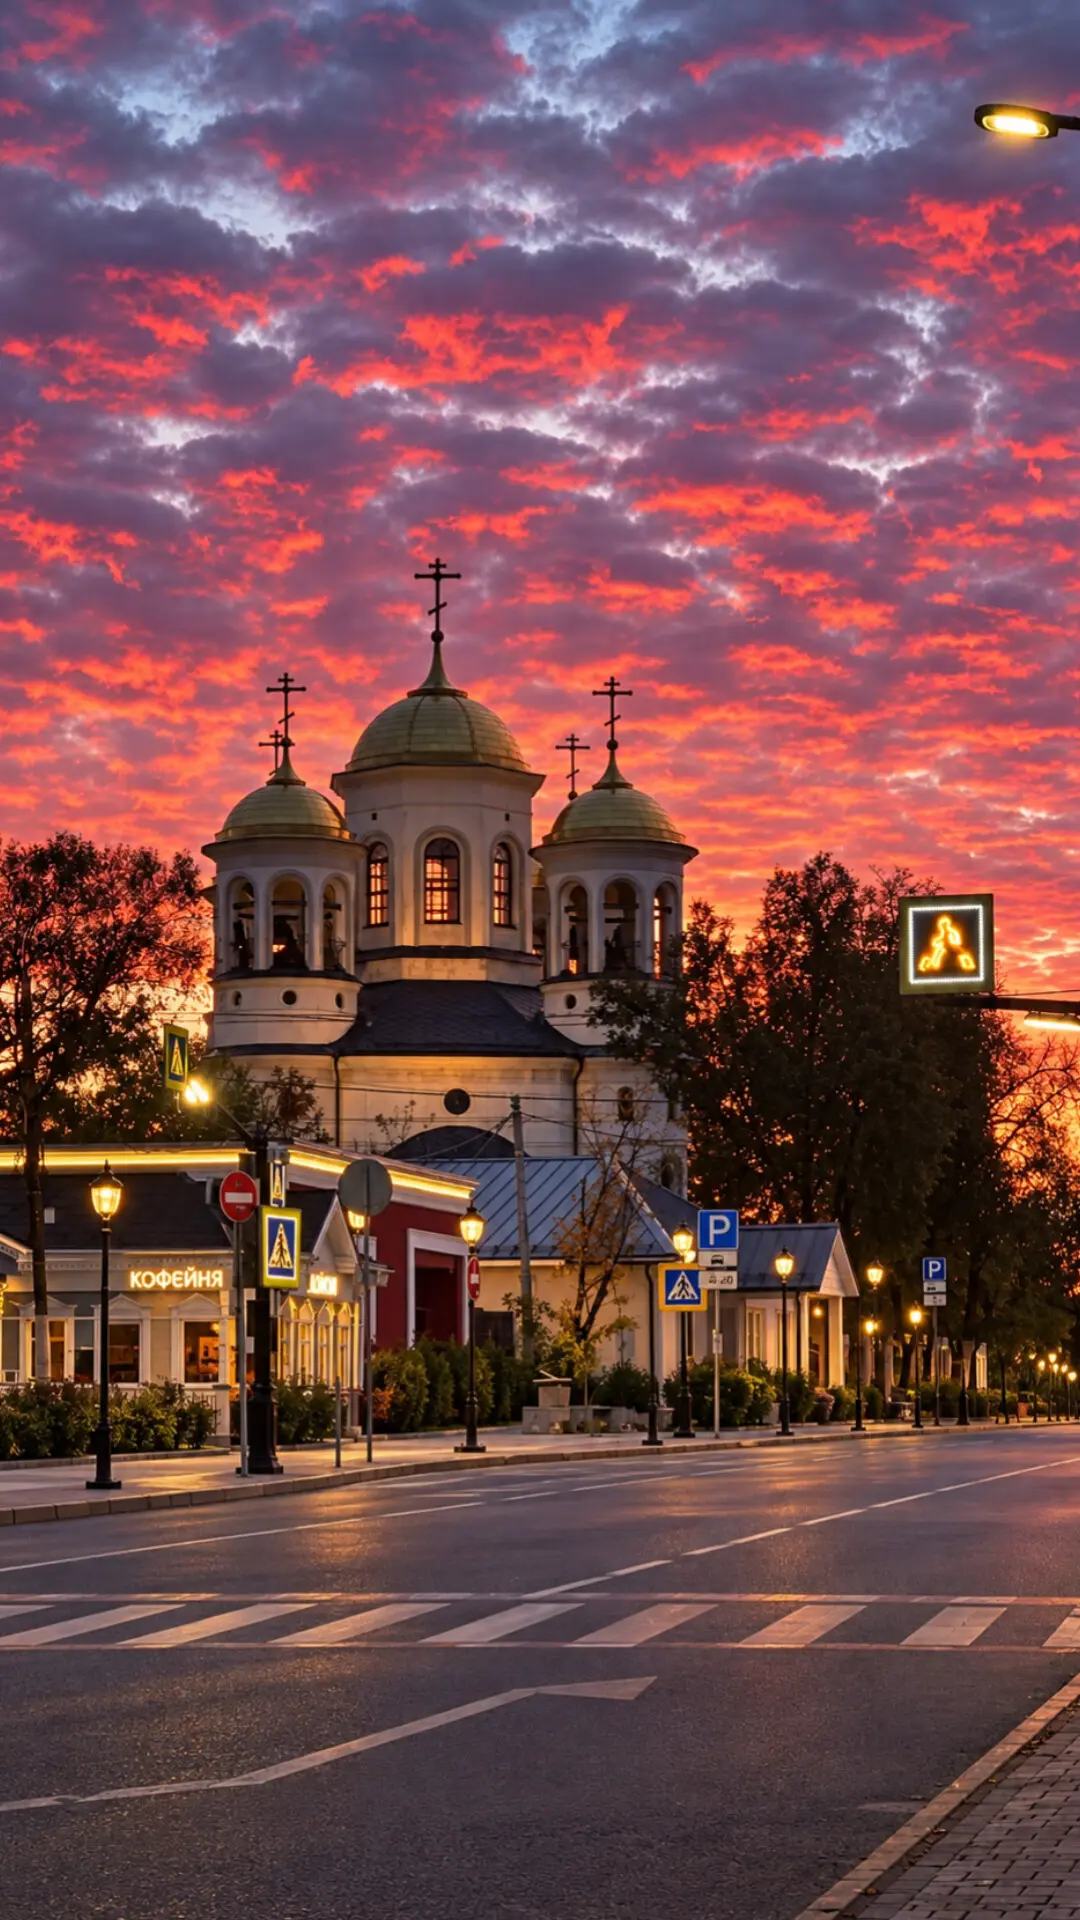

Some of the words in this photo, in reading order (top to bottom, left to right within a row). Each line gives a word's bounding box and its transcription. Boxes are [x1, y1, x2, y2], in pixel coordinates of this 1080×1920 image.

[709, 1214, 731, 1246] P
[129, 1265, 224, 1290] КОФЕЙНЯ
[929, 1260, 941, 1278] P
